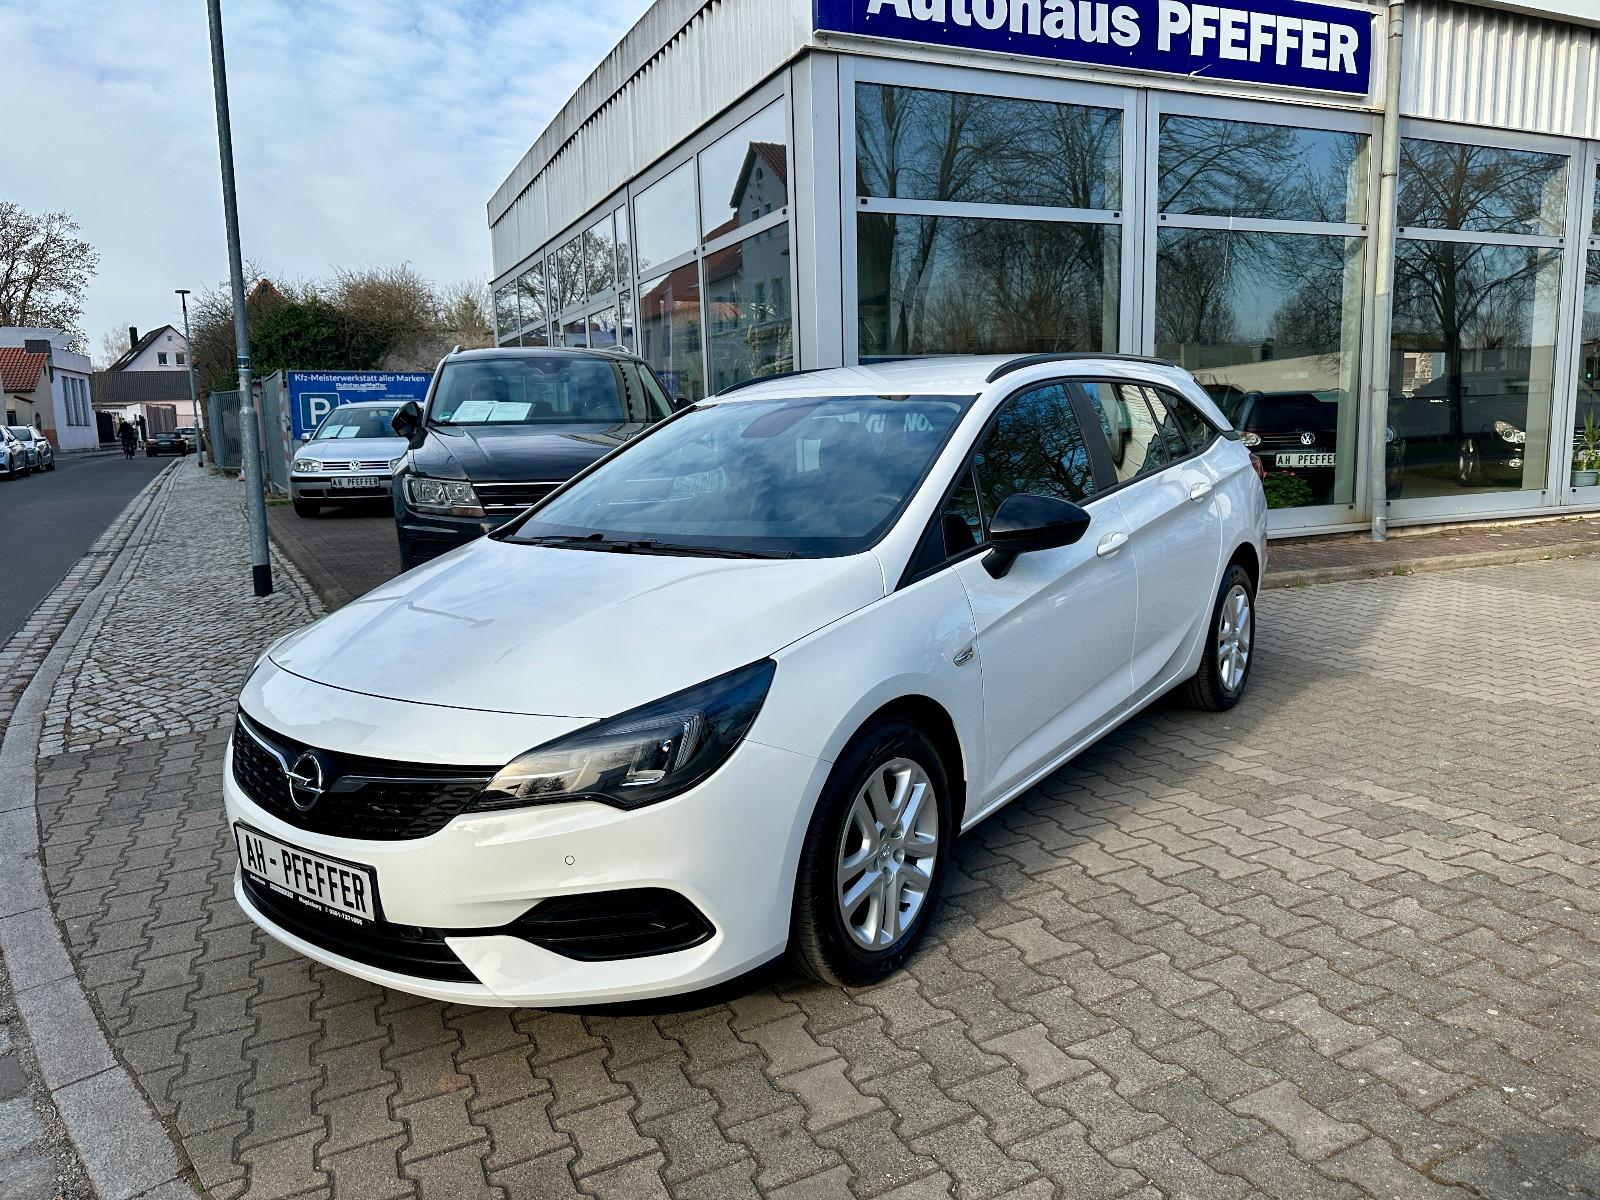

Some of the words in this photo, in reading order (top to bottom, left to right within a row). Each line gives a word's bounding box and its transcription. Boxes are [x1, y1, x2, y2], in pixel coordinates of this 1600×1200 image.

[1157, 0, 1358, 75] PFEFFER
[294, 373, 378, 382] Kfz-Meisterwerkstatt
[379, 374, 395, 382] aller
[396, 374, 425, 382] Marken
[310, 398, 330, 425] P
[1277, 455, 1291, 465] AH
[332, 479, 343, 487] AH
[347, 477, 378, 486] PFEFFER
[245, 834, 267, 875] AH
[281, 848, 367, 913] PFEFFER
